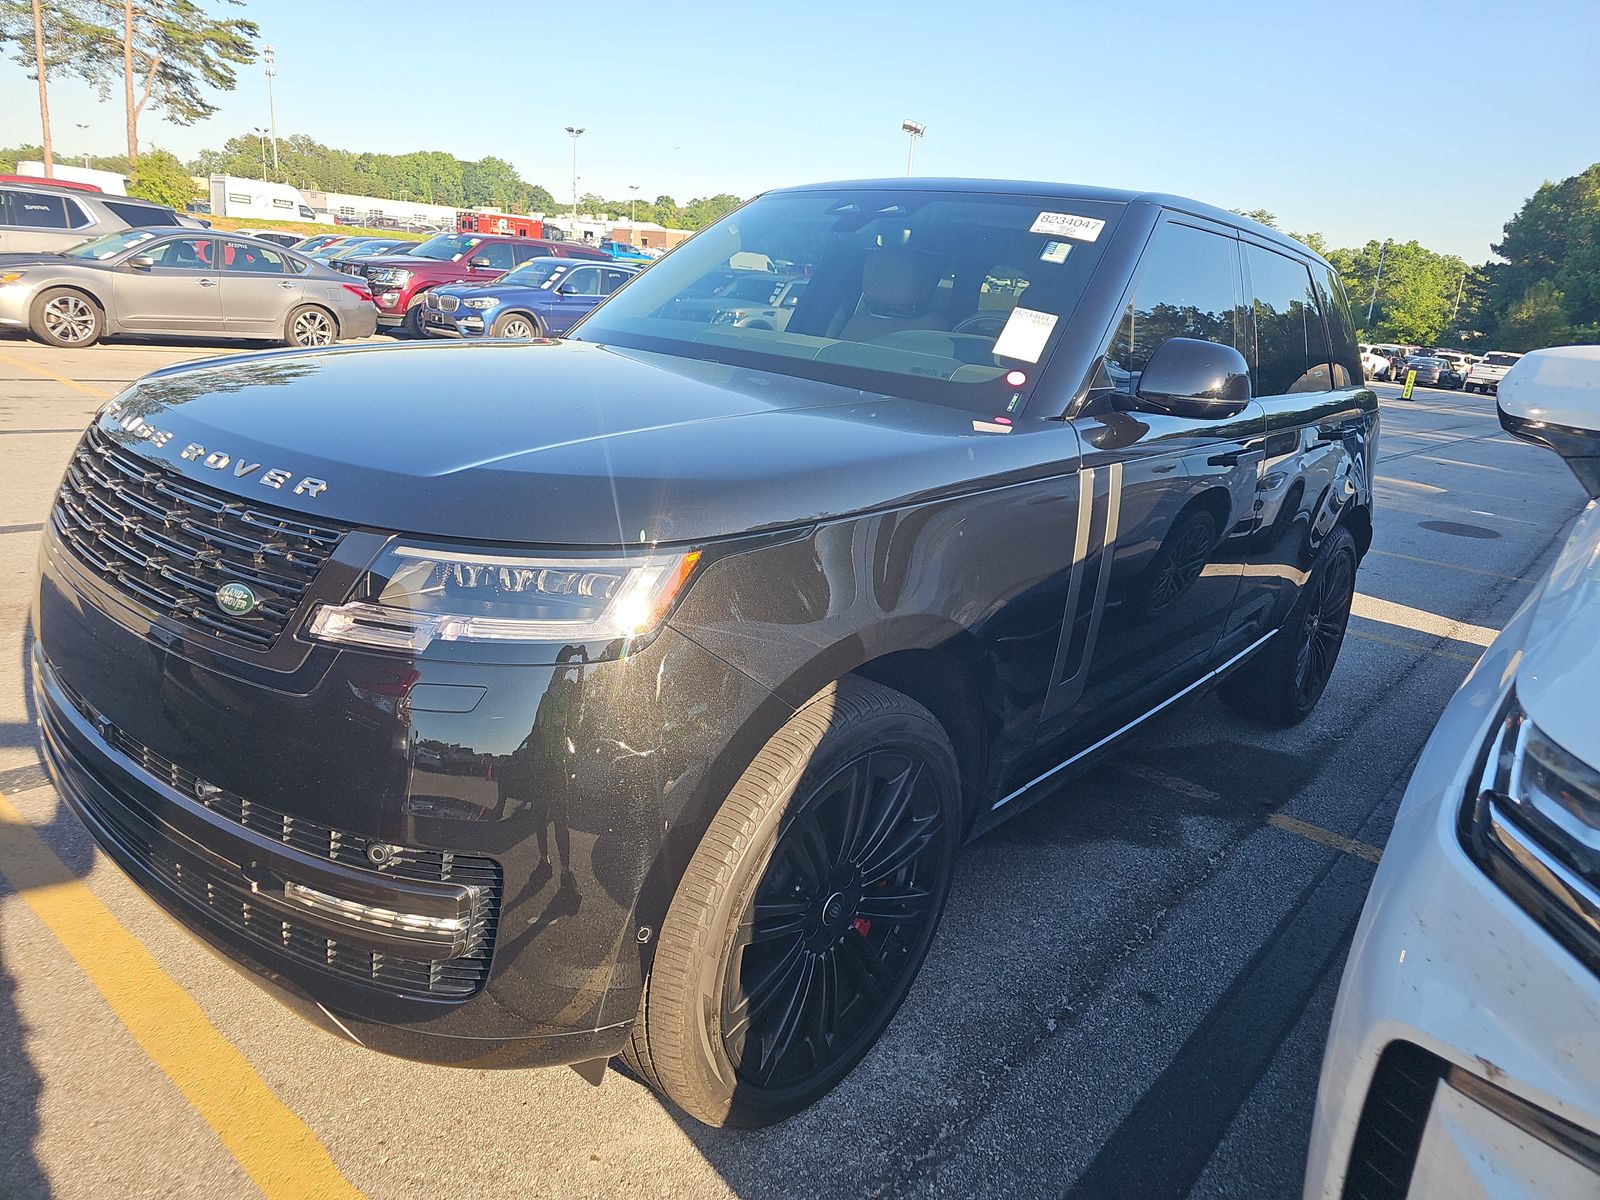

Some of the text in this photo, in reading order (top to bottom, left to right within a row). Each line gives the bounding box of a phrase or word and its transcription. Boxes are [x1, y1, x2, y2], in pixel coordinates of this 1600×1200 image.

[1040, 214, 1100, 230] 8234047
[1404, 371, 1415, 397] CLOSED
[180, 442, 328, 498] ROVER
[224, 586, 245, 599] LAND
[223, 595, 248, 610] ROVER
